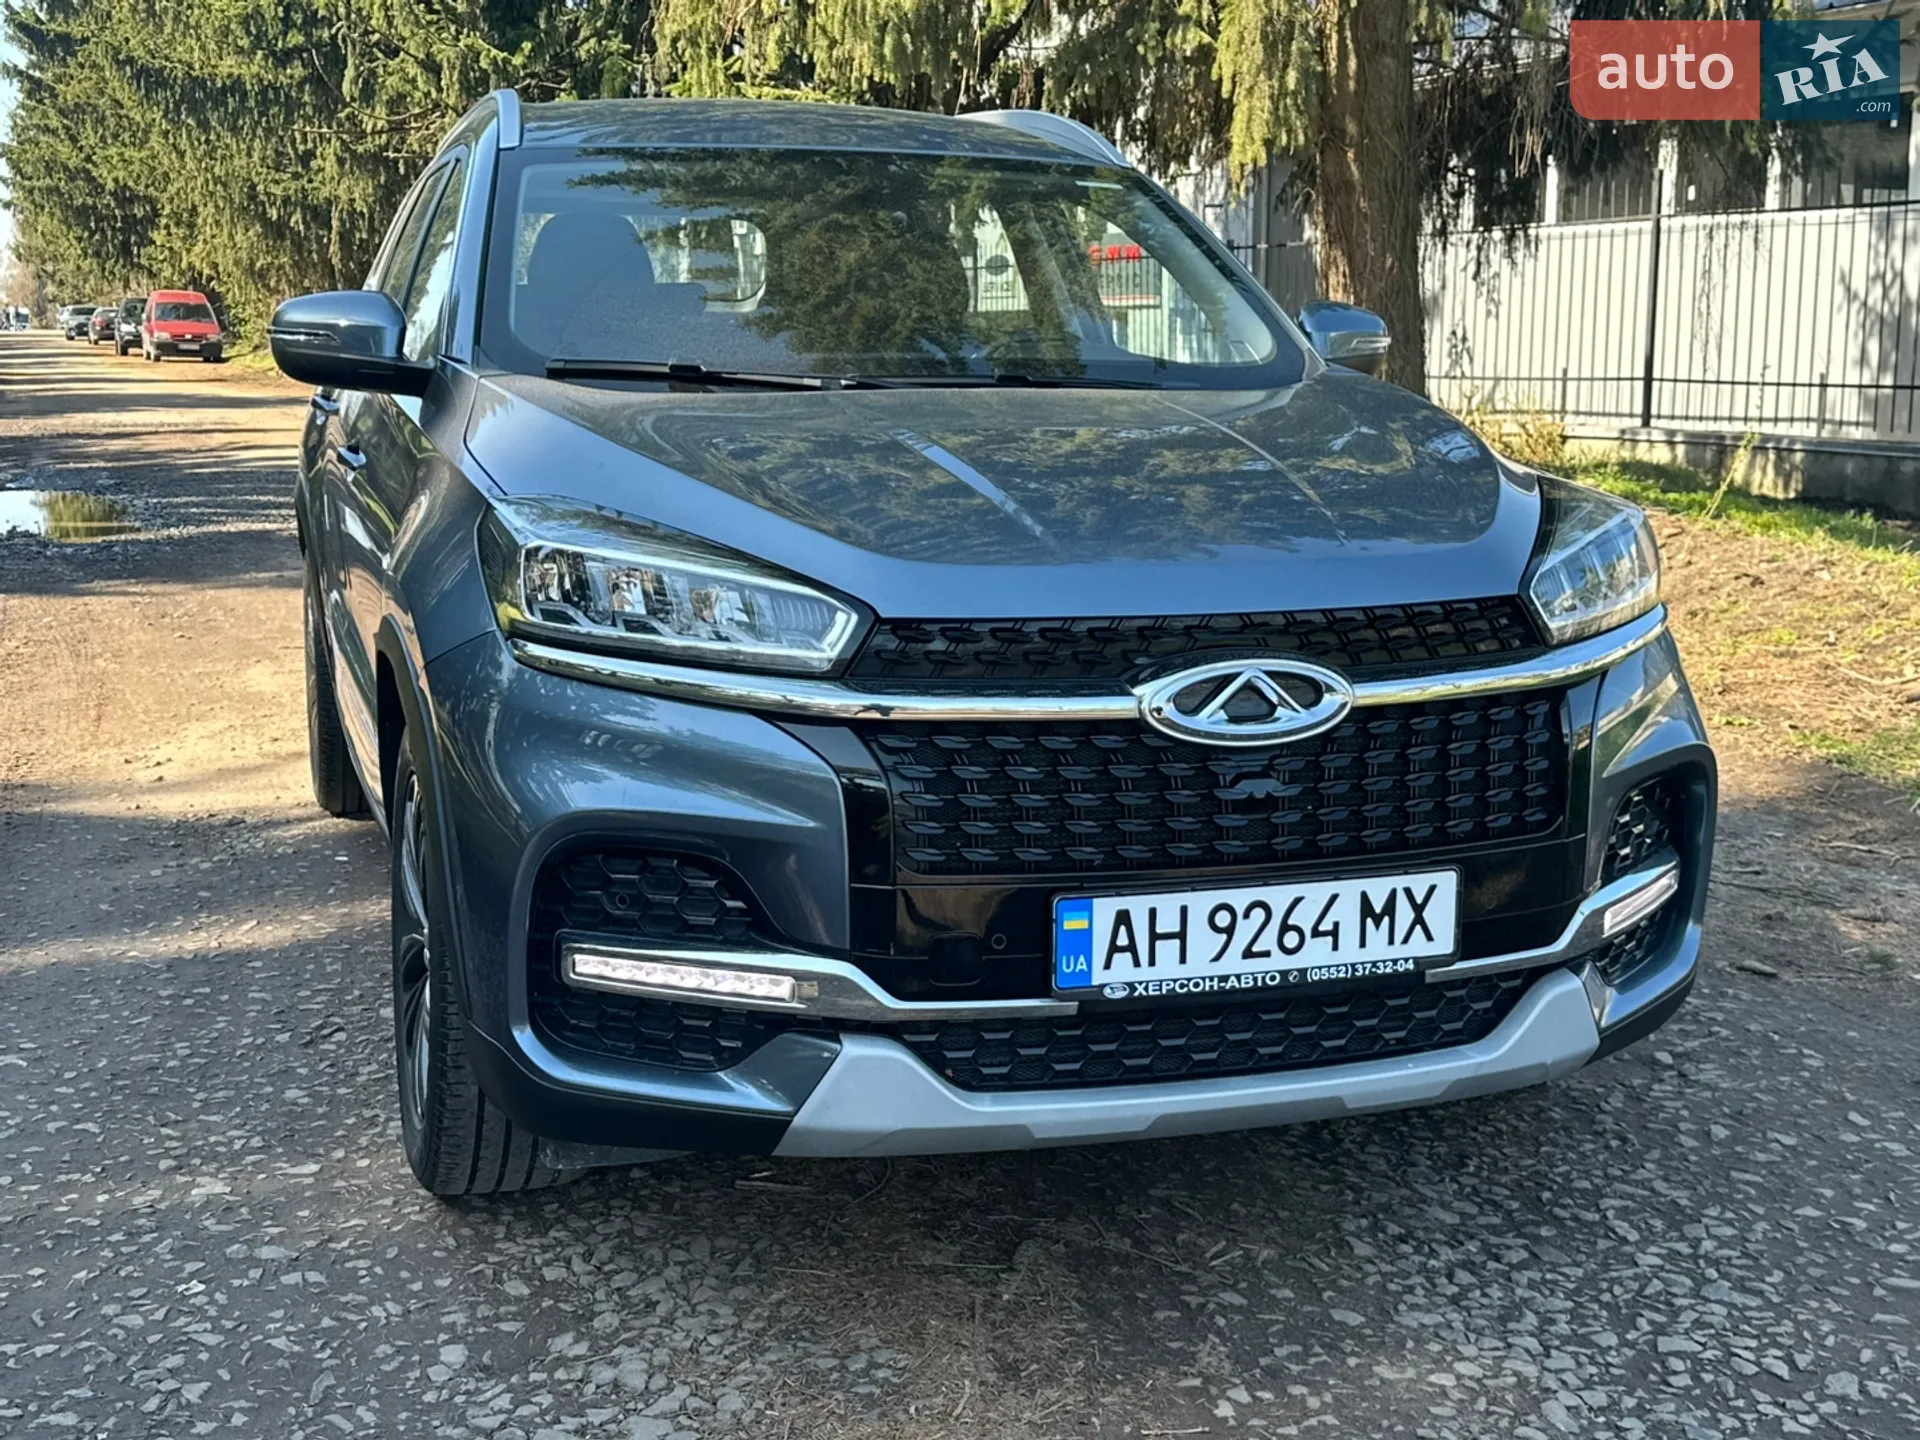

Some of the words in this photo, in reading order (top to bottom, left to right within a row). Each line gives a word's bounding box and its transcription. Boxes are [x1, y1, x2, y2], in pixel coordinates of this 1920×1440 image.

[1102, 904, 1189, 971] AH
[1206, 892, 1341, 963] 9264
[1358, 883, 1438, 950] MX
[1061, 953, 1089, 973] UA
[1132, 971, 1281, 997] ХЕРСОН-АВТО
[1306, 964, 1352, 983] (0552)
[1354, 958, 1415, 977] 37-32-04
